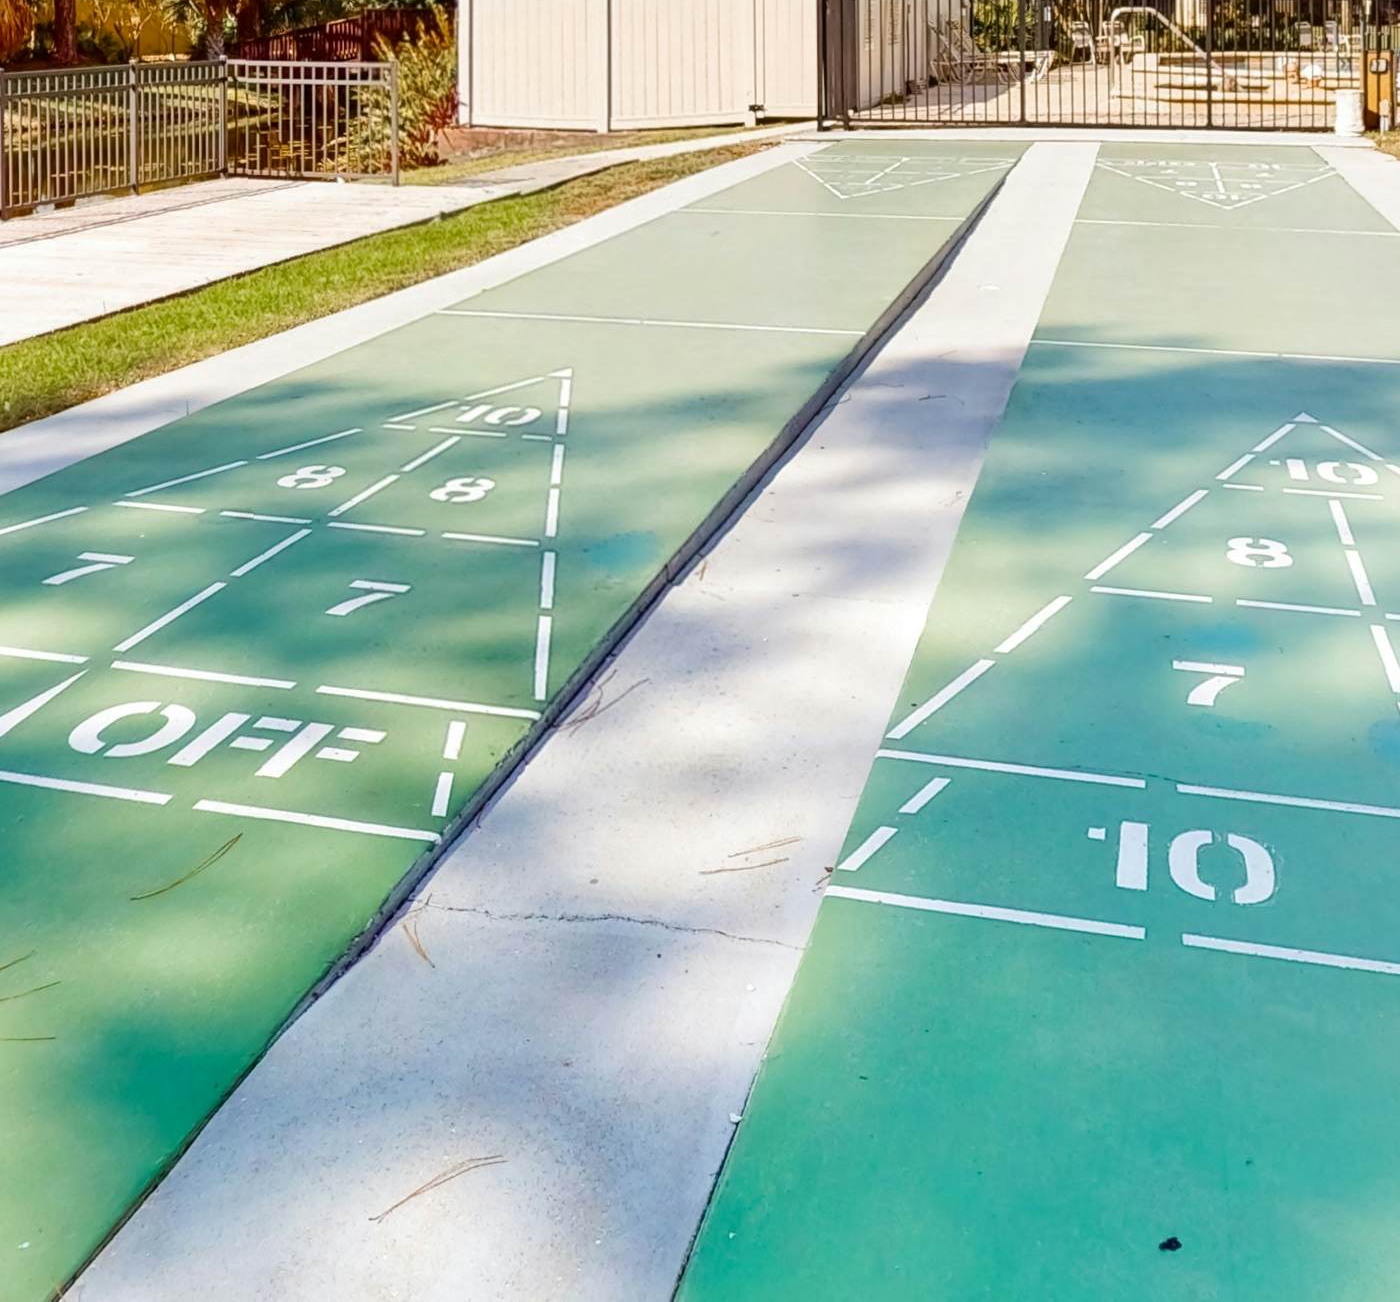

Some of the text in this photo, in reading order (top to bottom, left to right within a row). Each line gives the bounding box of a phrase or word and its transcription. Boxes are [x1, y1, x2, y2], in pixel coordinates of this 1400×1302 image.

[454, 403, 542, 427] 10
[277, 464, 347, 490] 8
[1269, 458, 1381, 486] 10
[429, 476, 496, 504] 8
[41, 552, 136, 586] 7
[1226, 536, 1294, 569] 8
[325, 579, 412, 616] 7
[1172, 661, 1245, 707] 7
[68, 701, 387, 778] OFF
[1087, 820, 1278, 905] 10
